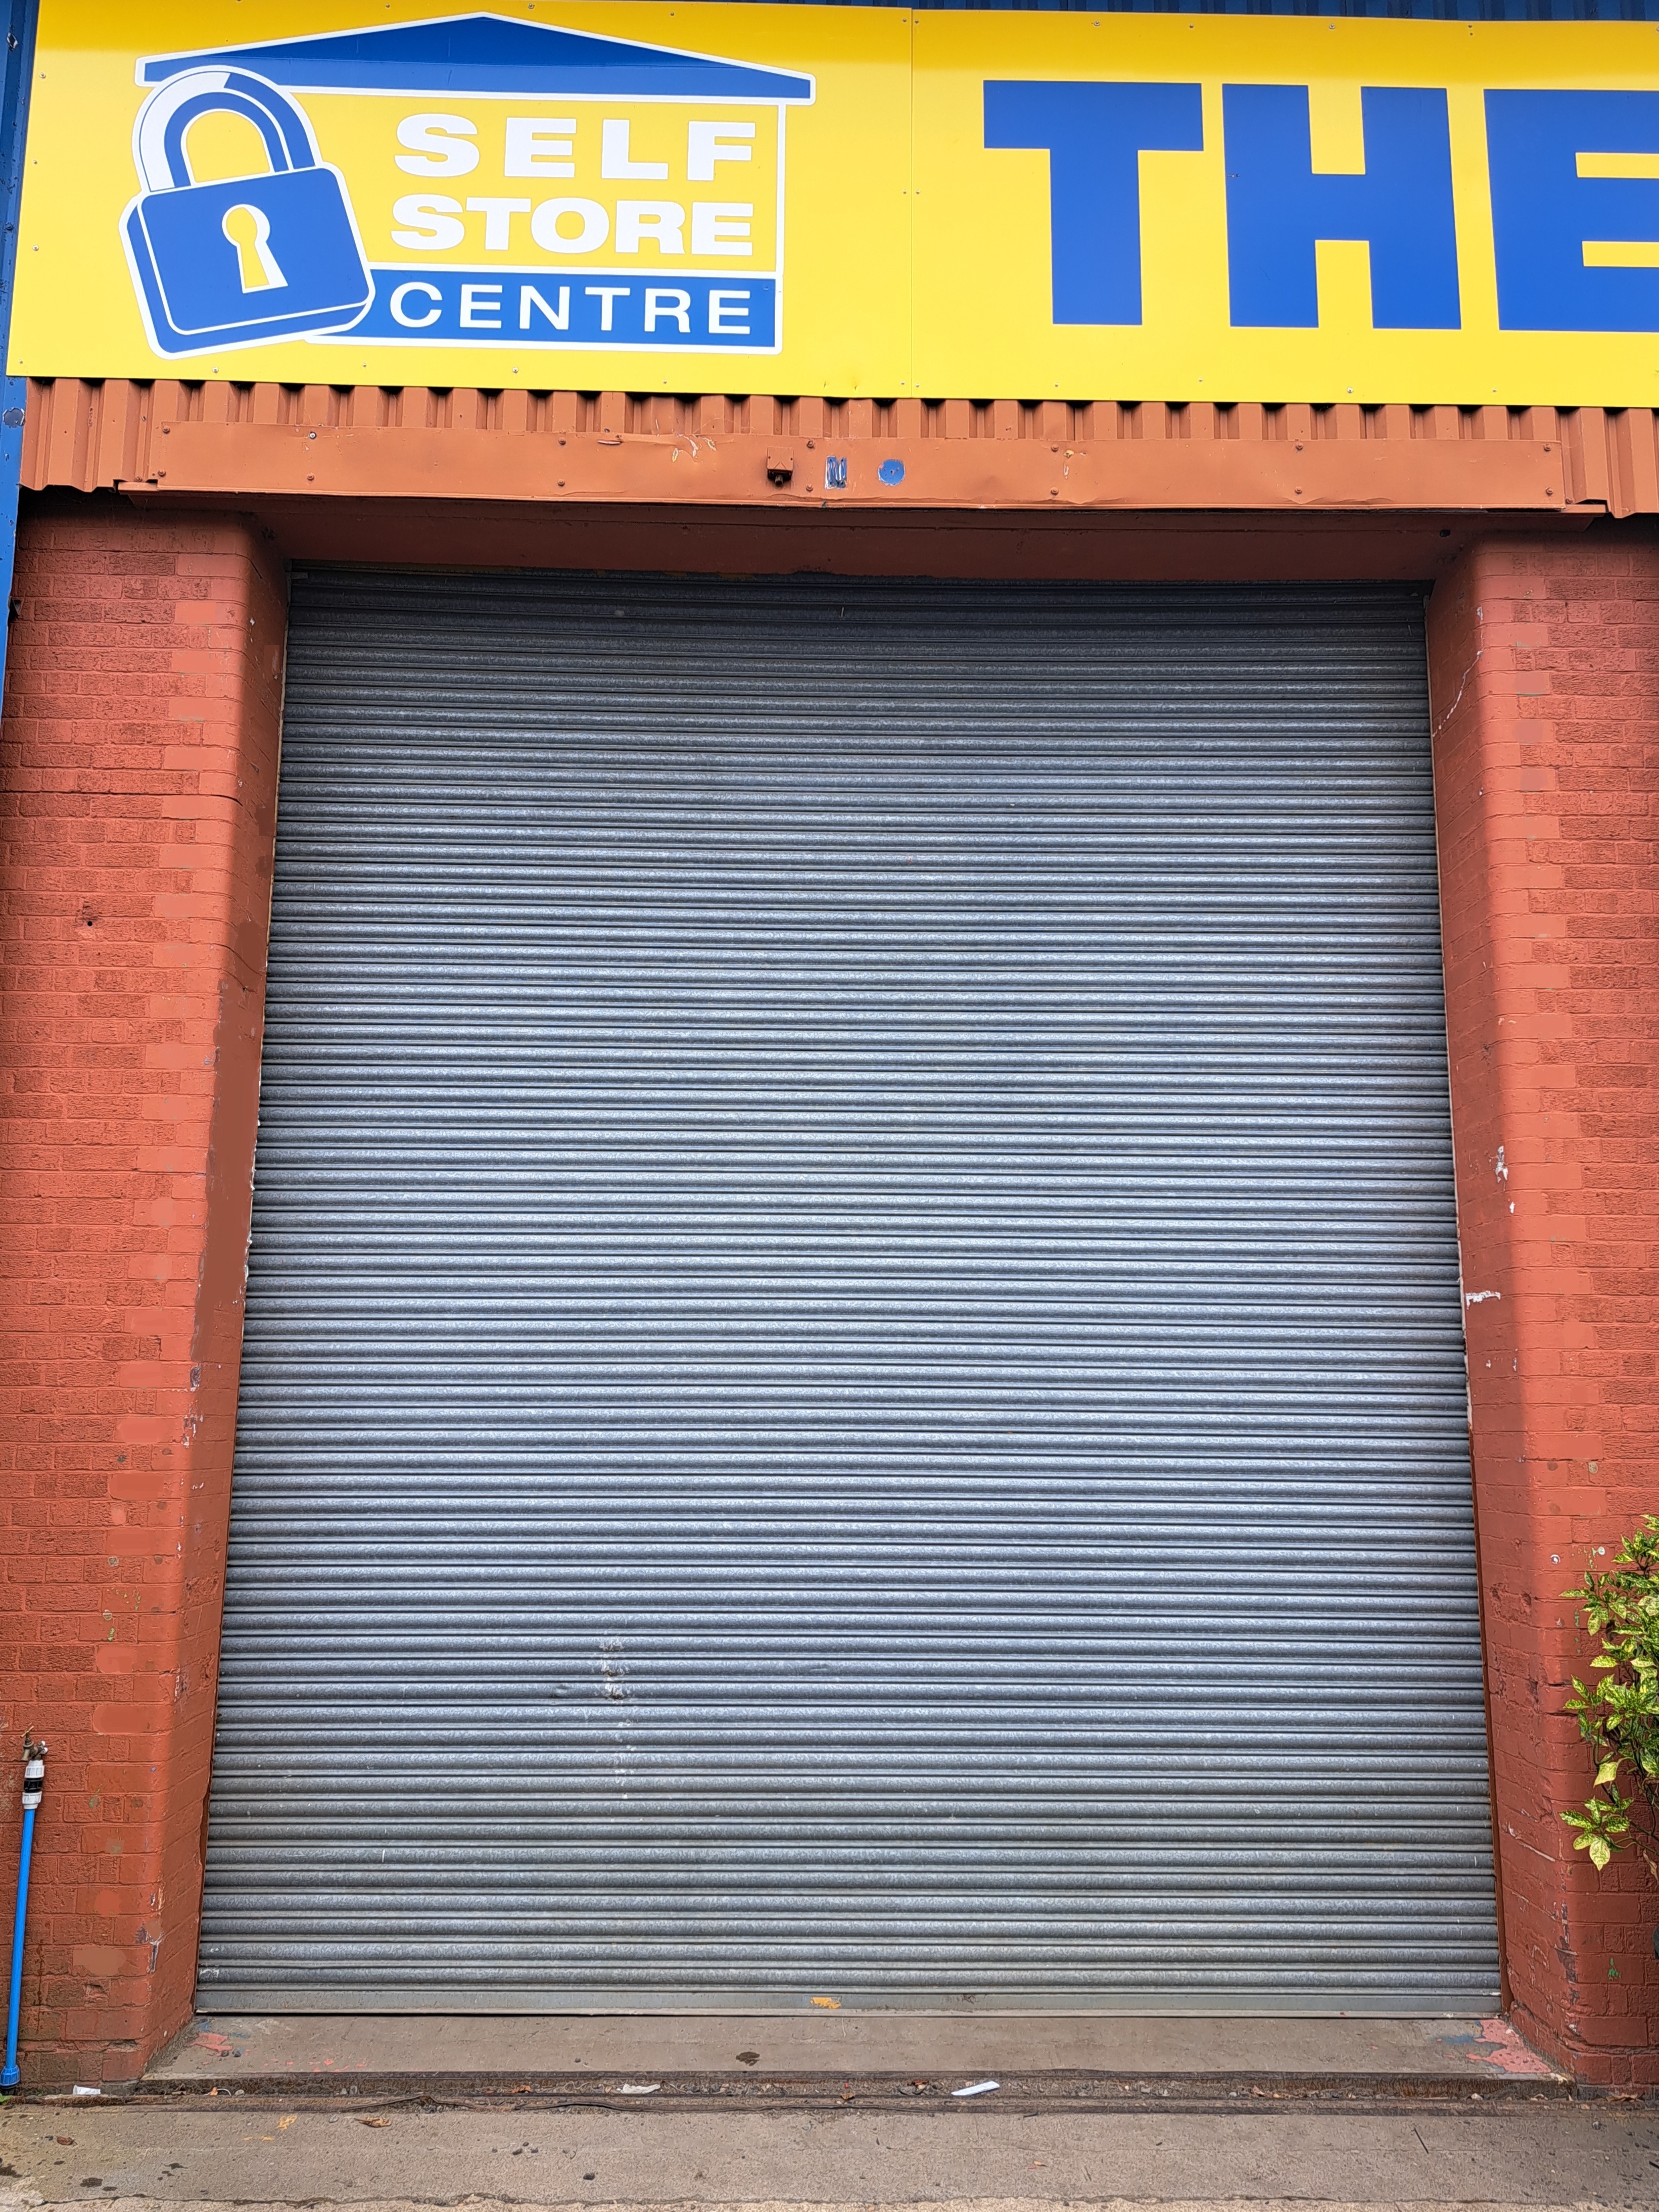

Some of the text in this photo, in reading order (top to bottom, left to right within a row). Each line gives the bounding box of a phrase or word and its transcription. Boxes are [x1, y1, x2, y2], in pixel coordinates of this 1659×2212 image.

[394, 113, 756, 182] SELF
[390, 194, 754, 257] STORE
[983, 80, 1659, 333] THE
[390, 282, 750, 334] CENTRE
